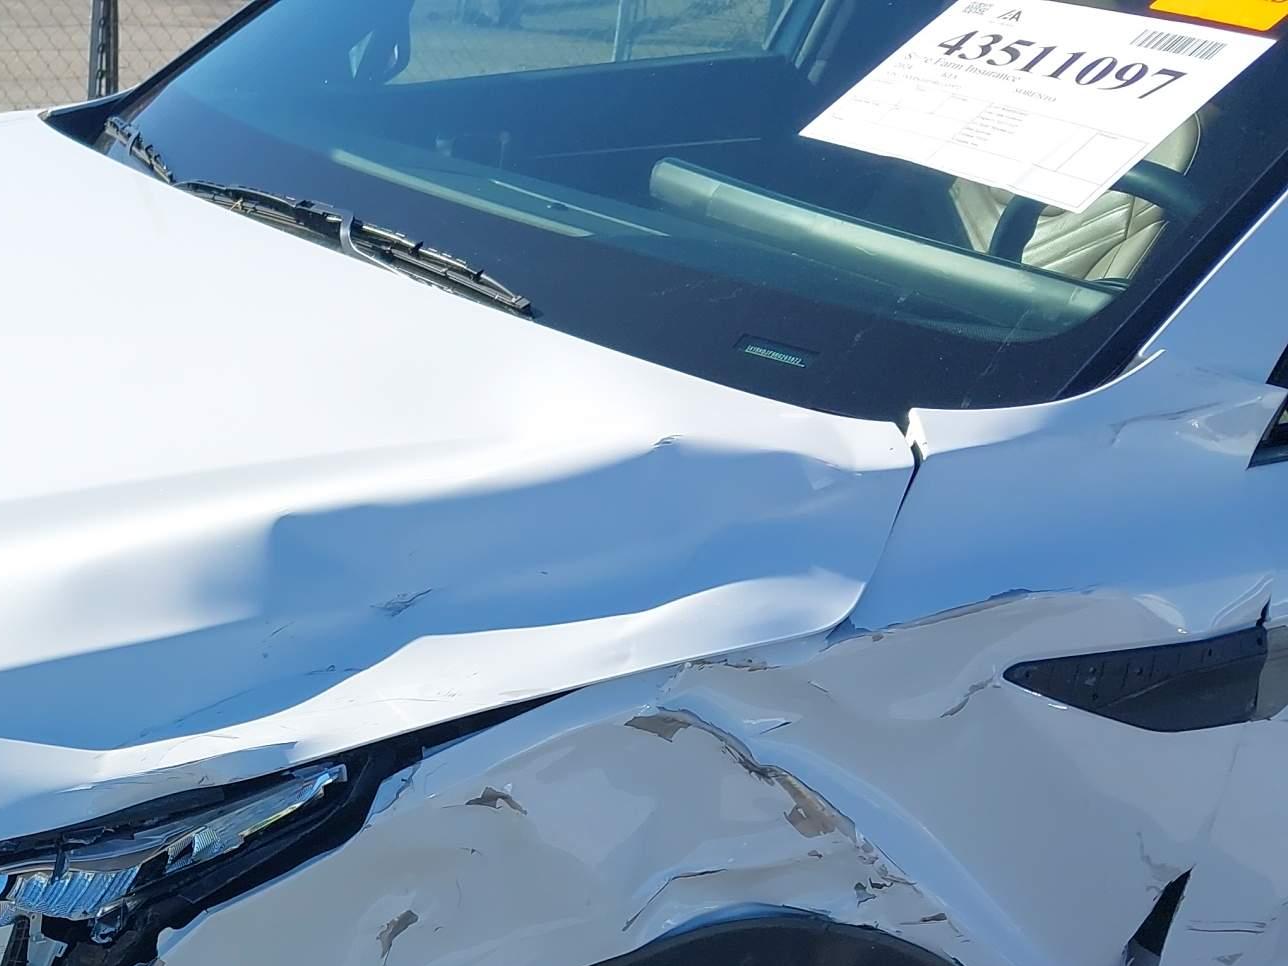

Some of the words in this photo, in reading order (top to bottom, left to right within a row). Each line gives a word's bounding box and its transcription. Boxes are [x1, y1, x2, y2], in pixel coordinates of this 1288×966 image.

[937, 30, 1187, 99] 43511097
[966, 63, 1021, 83] Insurance
[1014, 87, 1057, 103] SORENTO
